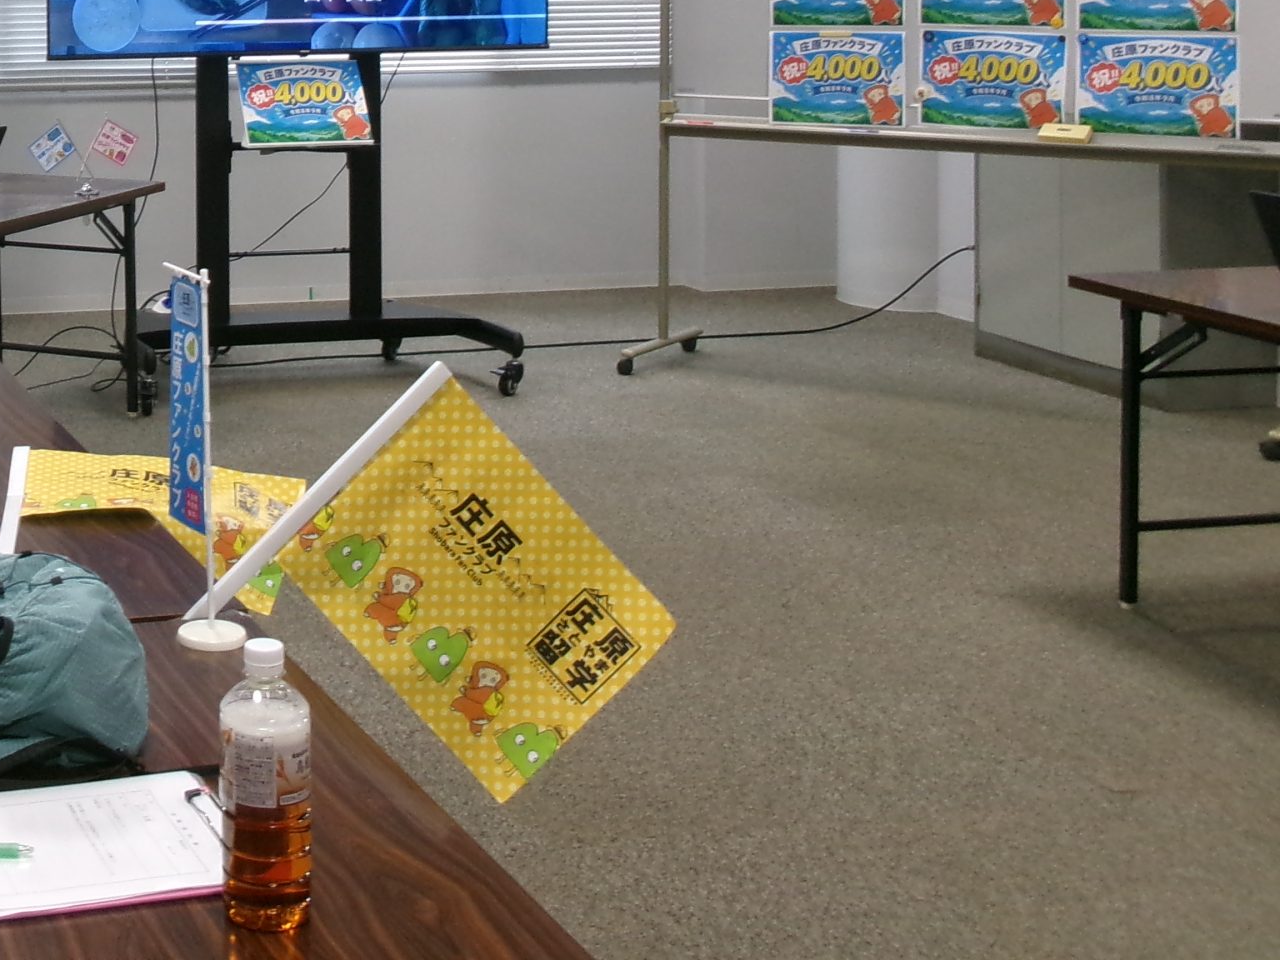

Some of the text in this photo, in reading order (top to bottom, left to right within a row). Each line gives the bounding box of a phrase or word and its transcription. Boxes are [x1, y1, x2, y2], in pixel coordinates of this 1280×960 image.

[264, 67, 337, 81] 庄原ファンクラブ
[800, 39, 878, 52] 庄原ファンクラブ
[951, 39, 1036, 53] 庄原ファンクラブ
[1111, 44, 1207, 58] 庄原ファンクラブ
[171, 331, 184, 508] 庄原ファンクラブ
[438, 516, 497, 575] ファンクラブ
[450, 493, 523, 566] 庄原
[534, 629, 600, 693] 留学
[565, 598, 635, 666] 庄原
